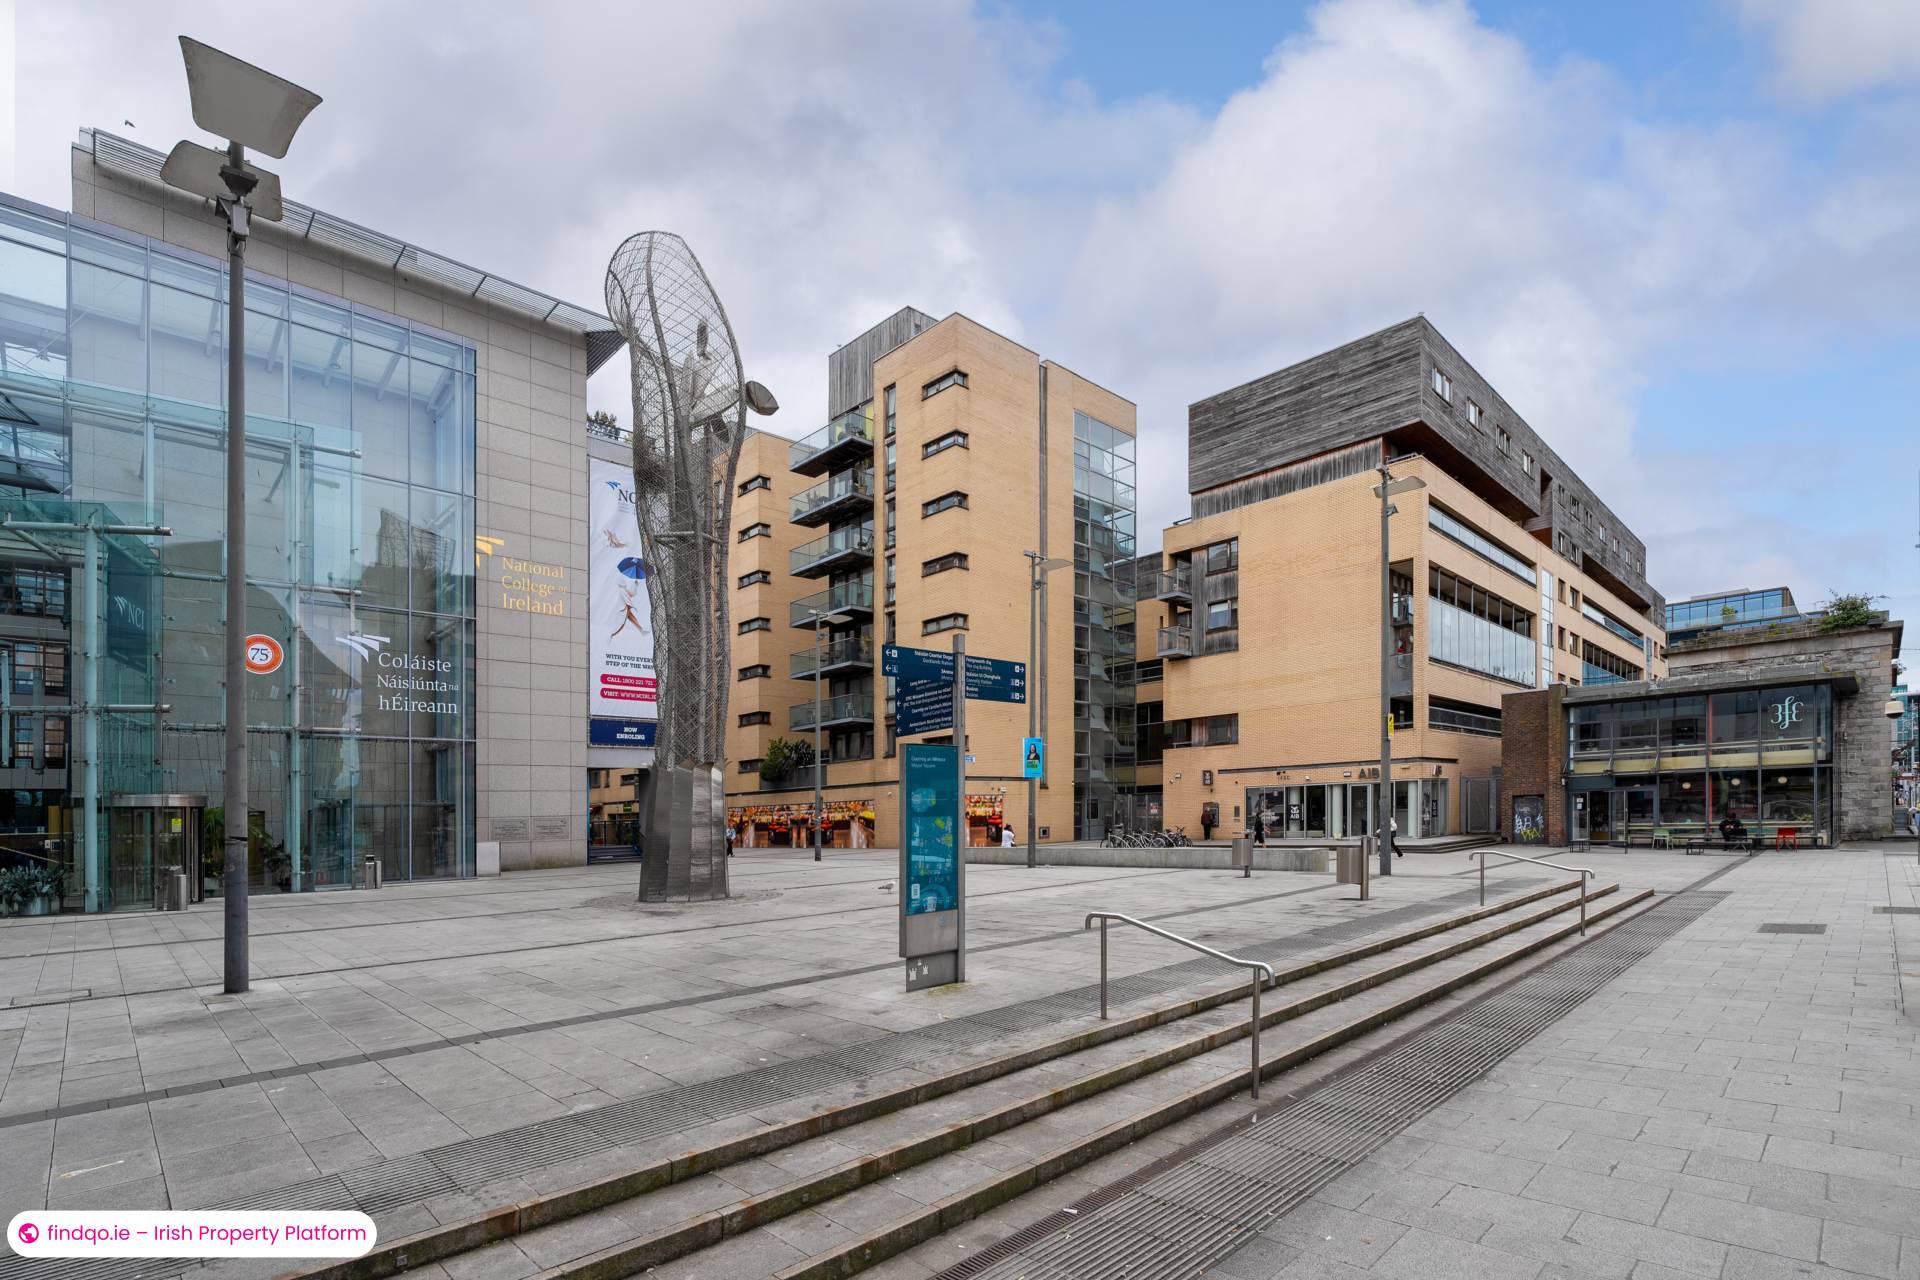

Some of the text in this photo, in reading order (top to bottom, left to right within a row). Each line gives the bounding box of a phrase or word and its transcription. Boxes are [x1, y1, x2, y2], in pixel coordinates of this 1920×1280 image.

[617, 489, 636, 505] NC
[502, 556, 564, 578] National
[502, 576, 553, 597] College
[502, 593, 564, 616] Ireland
[128, 602, 145, 630] NCI
[250, 647, 269, 661] 75
[378, 652, 452, 673] Coláiste
[376, 674, 448, 692] Náisiúnta
[379, 693, 458, 714] hÉireann
[1359, 767, 1380, 779] AIB
